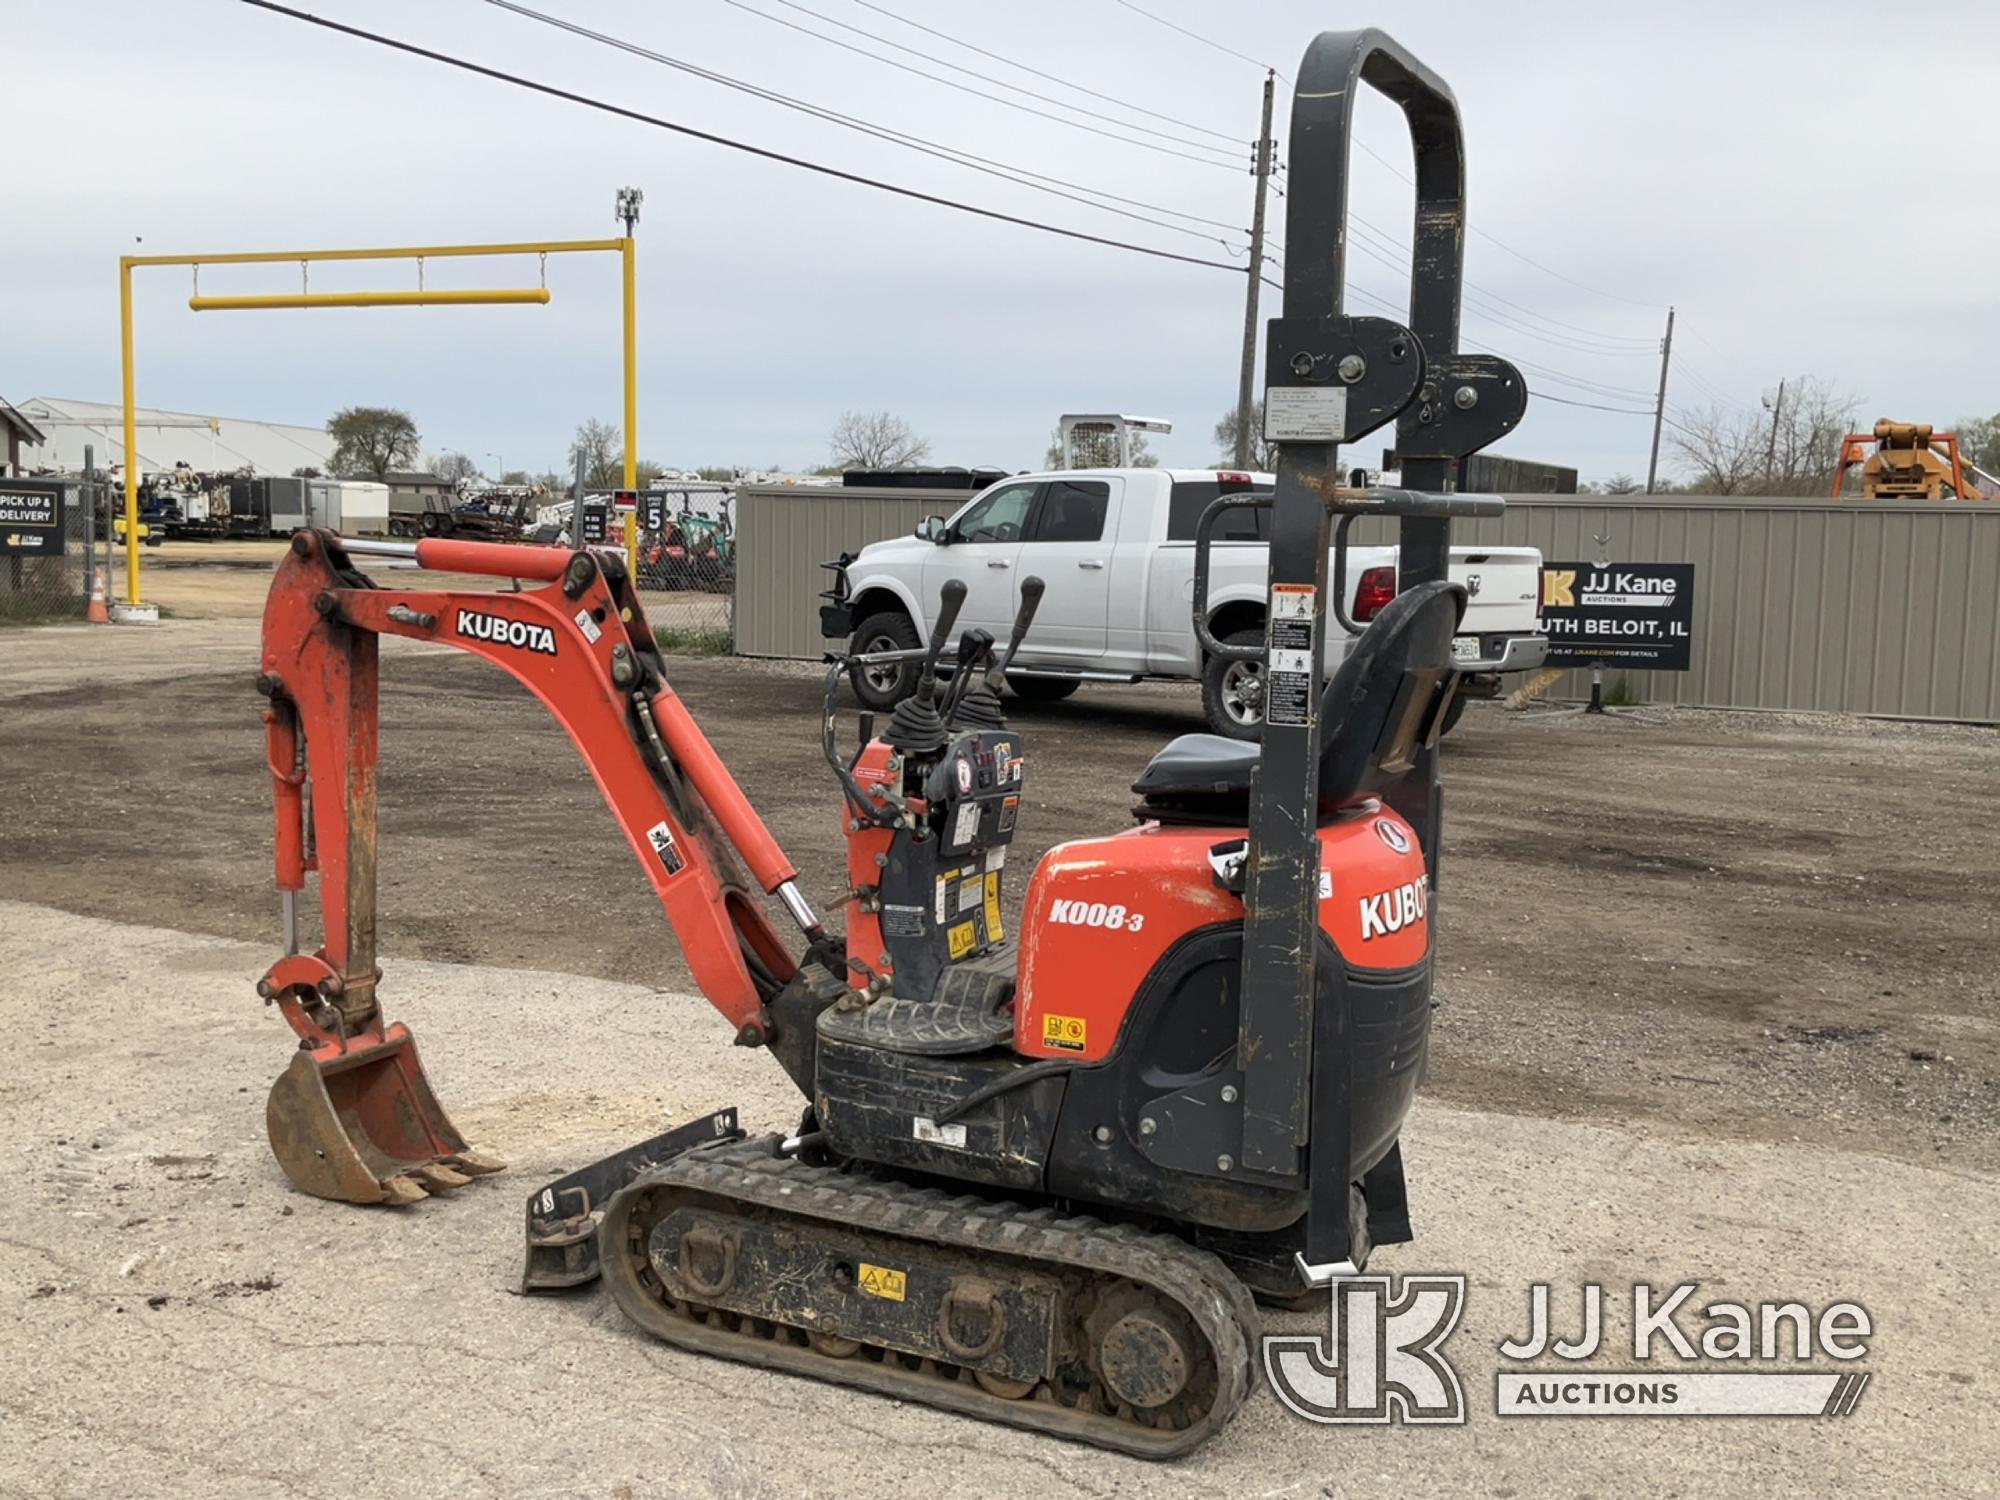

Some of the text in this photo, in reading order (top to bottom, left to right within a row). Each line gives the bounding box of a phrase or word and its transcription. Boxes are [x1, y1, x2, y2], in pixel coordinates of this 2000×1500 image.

[0, 496, 25, 506] PICK
[27, 497, 41, 507] UP
[0, 510, 51, 521] DELIVERY
[648, 509, 661, 529] 5
[1582, 573, 1677, 593] JJ Kane
[457, 609, 557, 654] KUBOTA
[1539, 618, 1688, 639] UTH BELOIT, IL
[1048, 899, 1144, 932] K008-3
